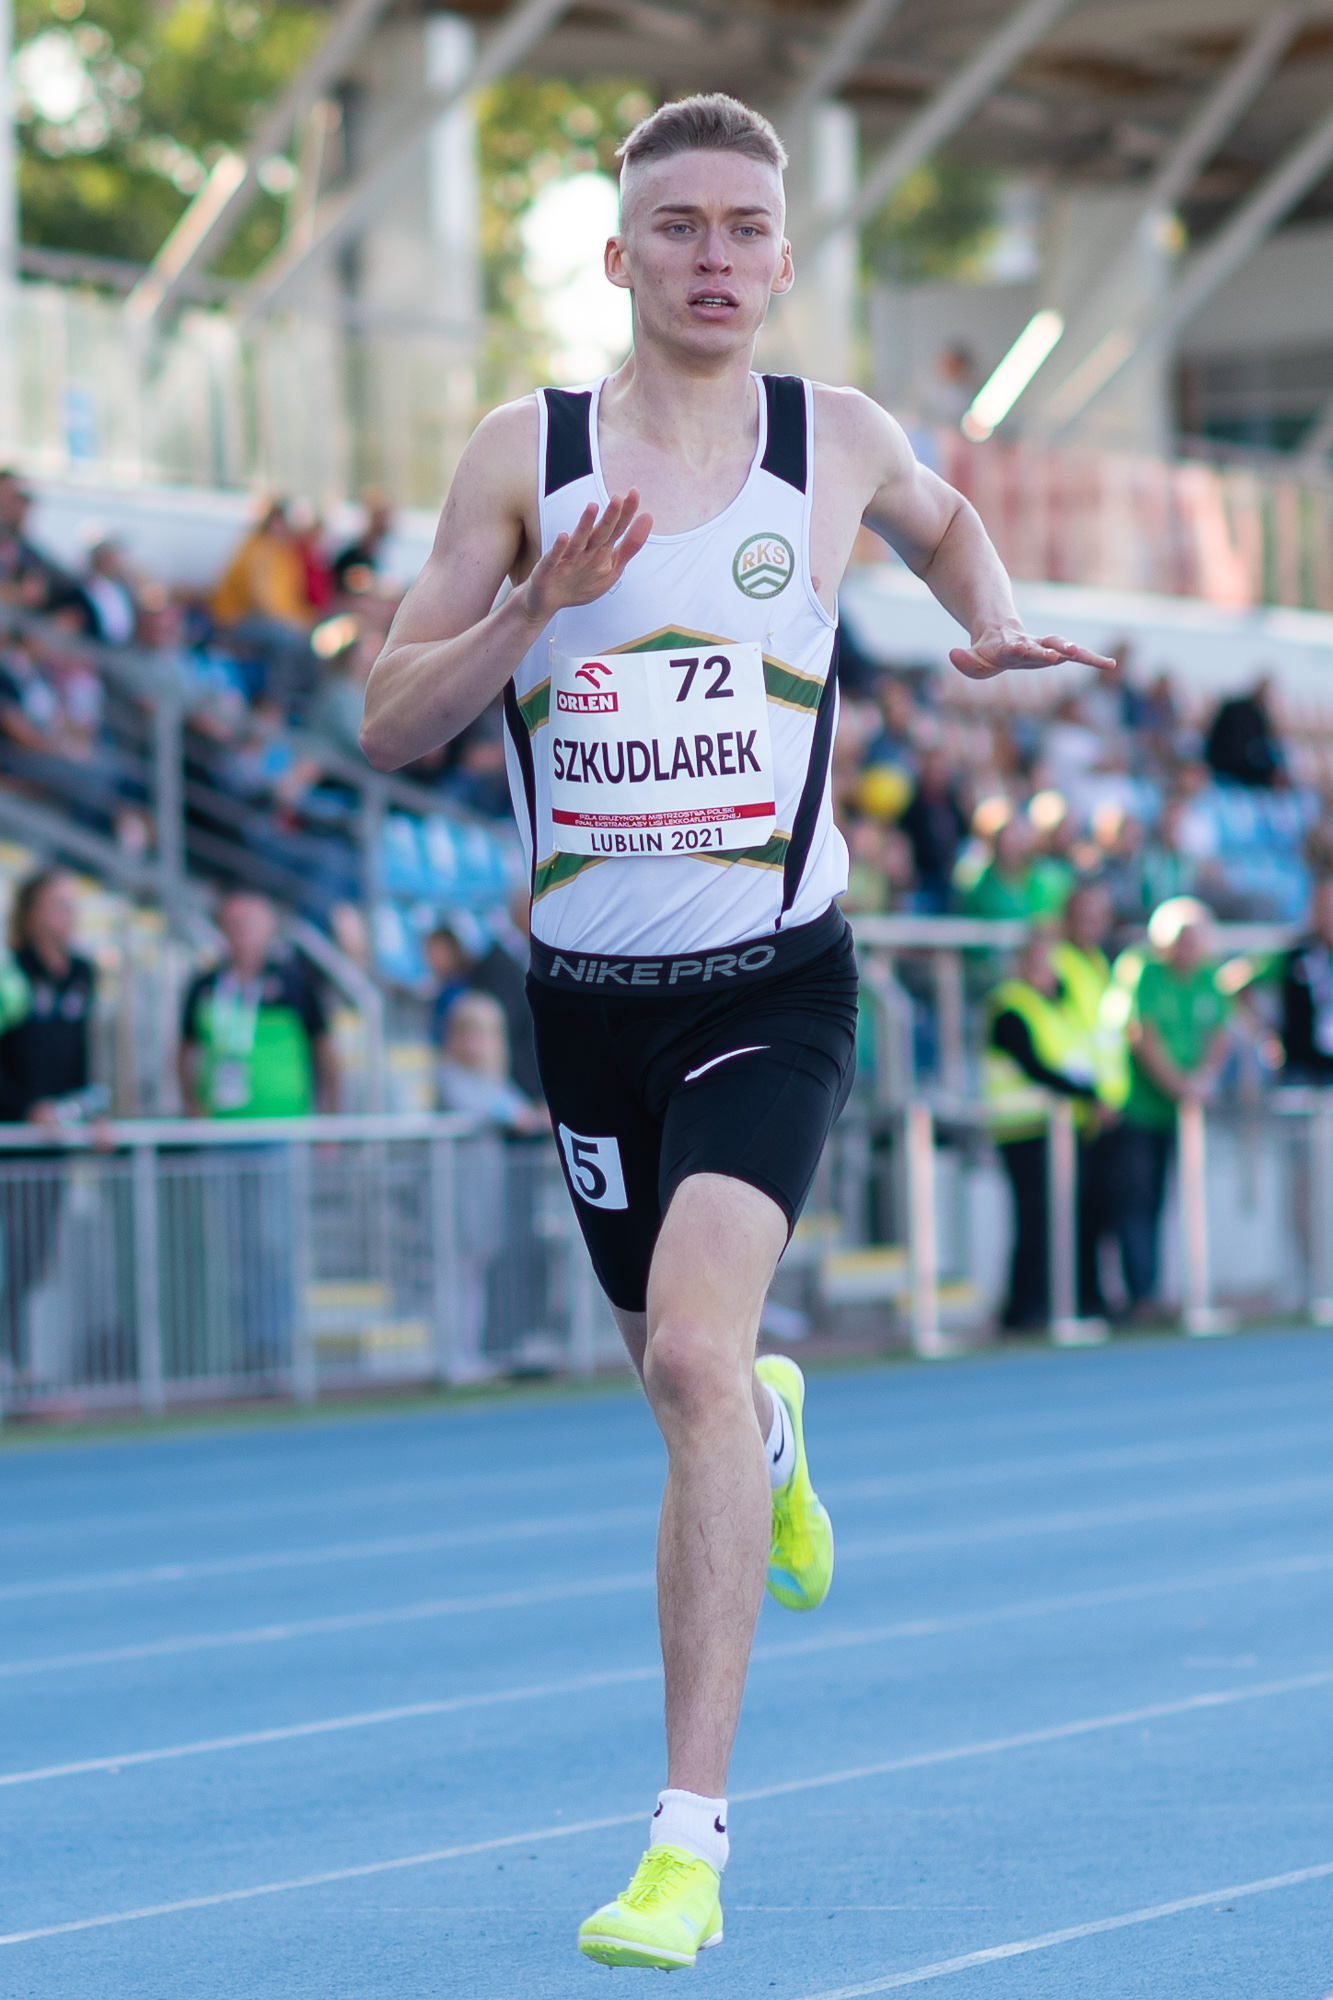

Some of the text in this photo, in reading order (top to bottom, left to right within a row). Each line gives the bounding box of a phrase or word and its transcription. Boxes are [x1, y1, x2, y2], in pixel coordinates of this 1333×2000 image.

[742, 541, 785, 571] RKS
[669, 655, 734, 702] 72
[558, 693, 614, 711] ORLEN
[553, 730, 761, 784] SZKUDLAREK
[706, 807, 735, 816] POLSKI
[591, 828, 723, 852] LUBLIN 2021
[549, 945, 776, 985] NIKE PRO
[570, 1136, 607, 1200] 5
